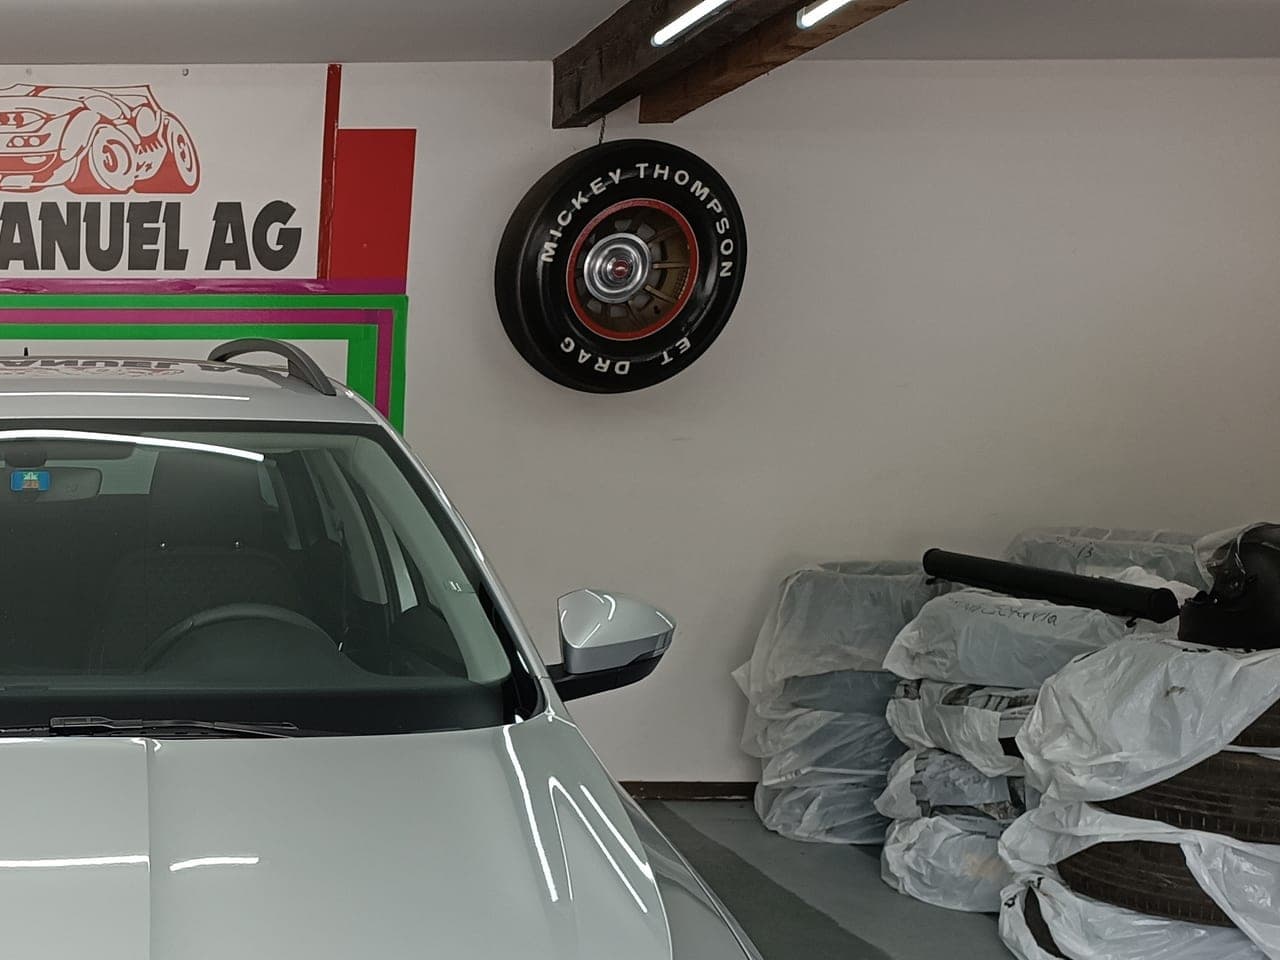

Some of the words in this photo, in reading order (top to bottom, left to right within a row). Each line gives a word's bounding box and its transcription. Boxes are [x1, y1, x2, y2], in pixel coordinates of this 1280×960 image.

[204, 200, 303, 271] AG
[541, 168, 621, 262] MICKEY
[635, 163, 734, 277] THOMPSON
[560, 336, 631, 375] DRAG
